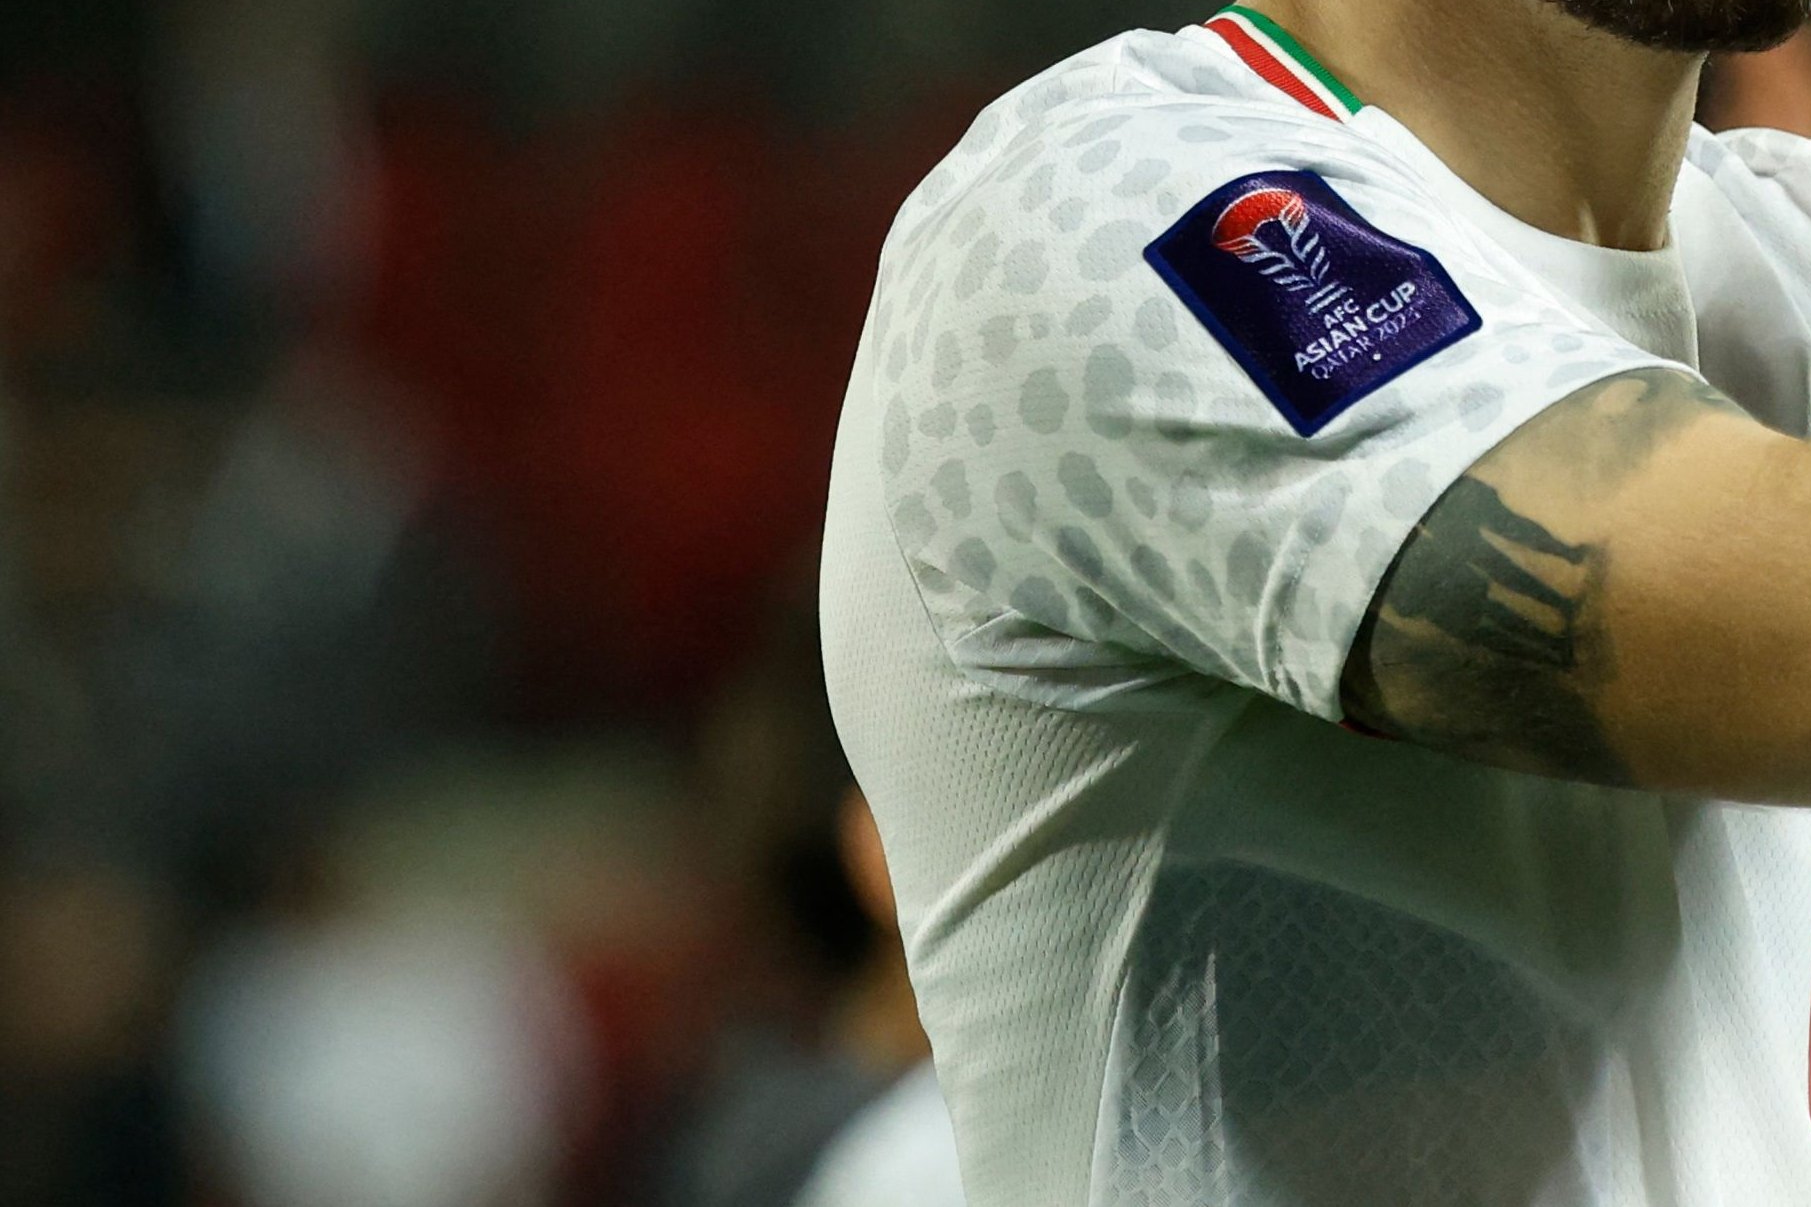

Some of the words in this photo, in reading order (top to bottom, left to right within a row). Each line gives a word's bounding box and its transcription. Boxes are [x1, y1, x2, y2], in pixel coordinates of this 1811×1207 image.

[1294, 316, 1369, 373] ASIAN
[1366, 282, 1416, 323] CUP
[1323, 298, 1360, 329] AFC
[1311, 336, 1375, 380] QATAR
